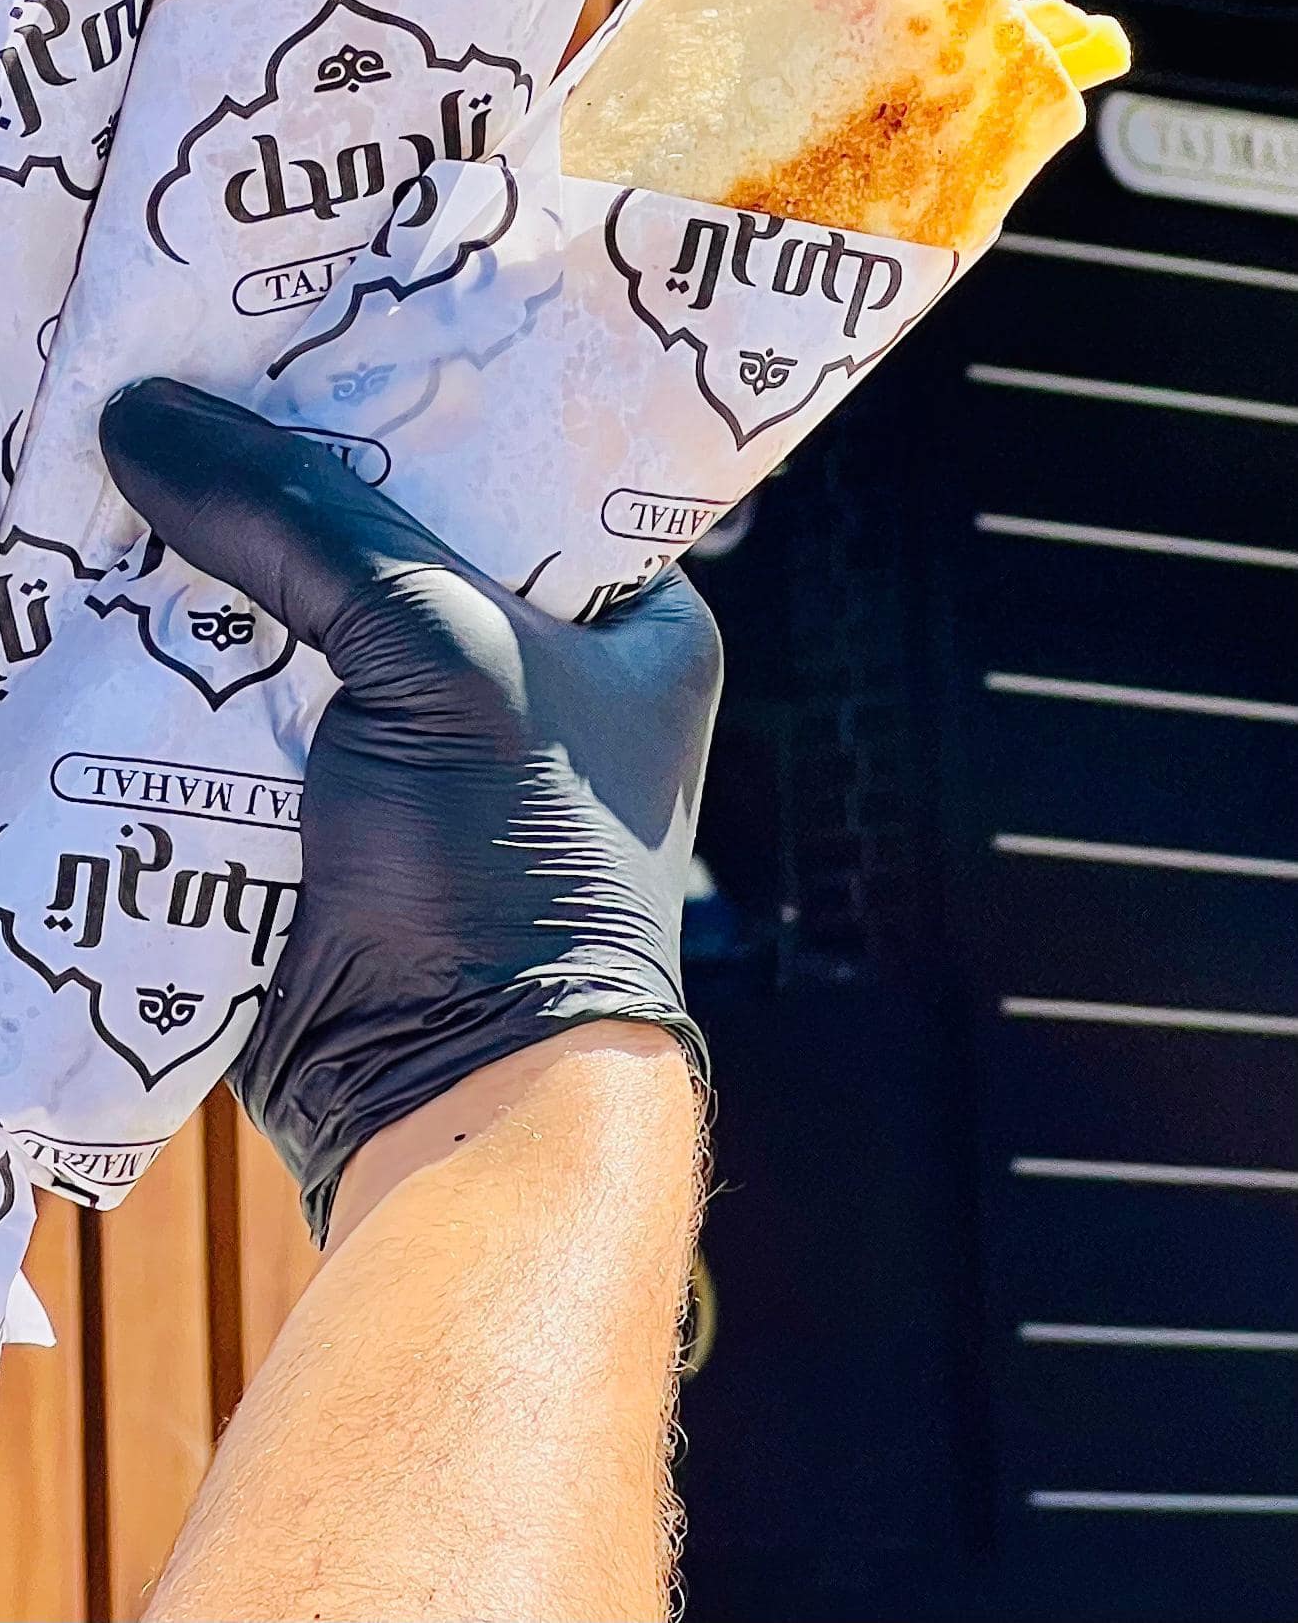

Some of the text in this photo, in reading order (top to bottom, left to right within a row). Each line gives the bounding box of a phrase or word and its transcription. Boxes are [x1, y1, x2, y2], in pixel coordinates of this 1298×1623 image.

[265, 263, 334, 301] TAJ
[83, 765, 304, 823] TAJ MAHAL
